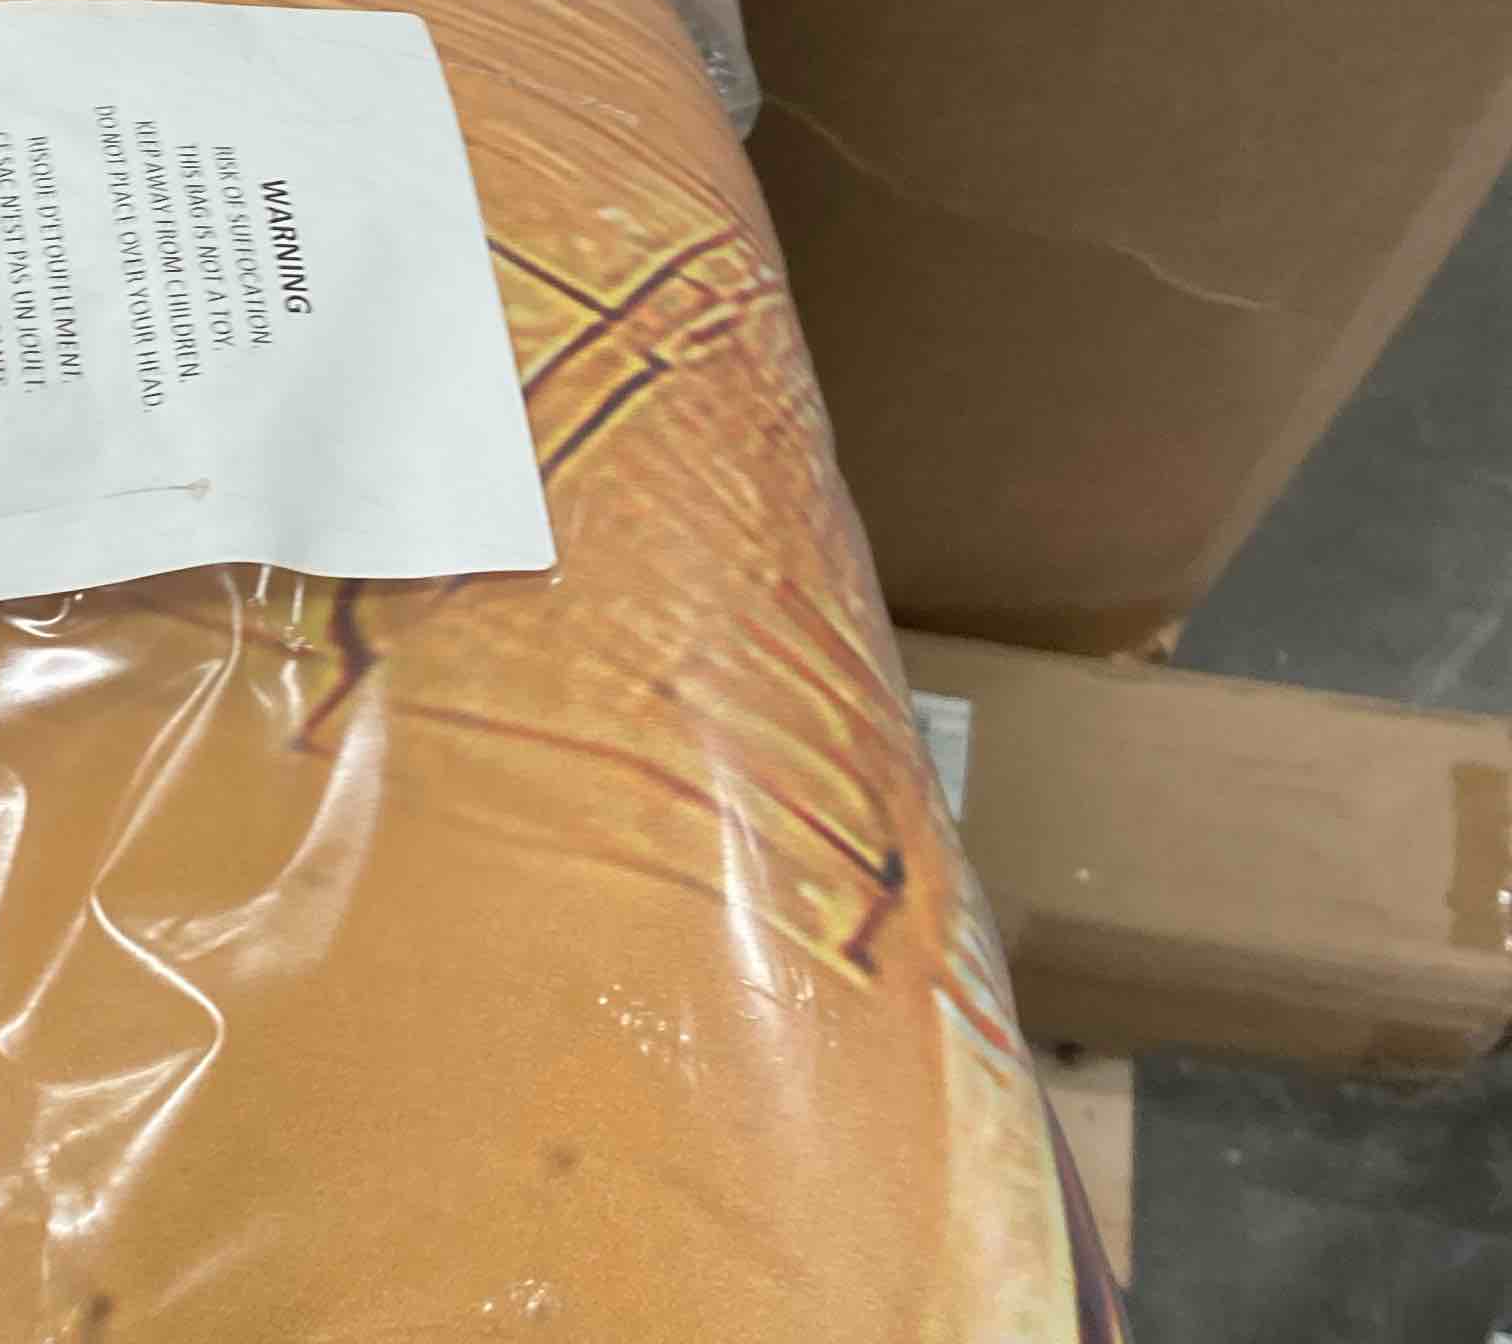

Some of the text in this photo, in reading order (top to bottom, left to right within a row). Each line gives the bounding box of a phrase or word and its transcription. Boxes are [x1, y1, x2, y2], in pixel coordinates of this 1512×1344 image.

[94, 105, 117, 128] DO
[99, 133, 127, 164] NOT
[134, 121, 160, 157] KEEP
[25, 136, 55, 199] RISQUE
[175, 144, 201, 178] THIS
[211, 146, 240, 180] RISK
[105, 172, 136, 223] PLACE
[143, 162, 173, 213] AWAY
[183, 185, 210, 218] BAG
[221, 186, 246, 207] OF
[153, 220, 183, 272] FROM
[191, 225, 213, 239] IS
[260, 179, 312, 314] WARNING
[6, 251, 31, 285] PAS
[119, 232, 146, 283] OVER
[196, 246, 224, 281] NOT
[10, 291, 37, 319] UN
[203, 290, 229, 303] A
[126, 287, 156, 344] YOUR
